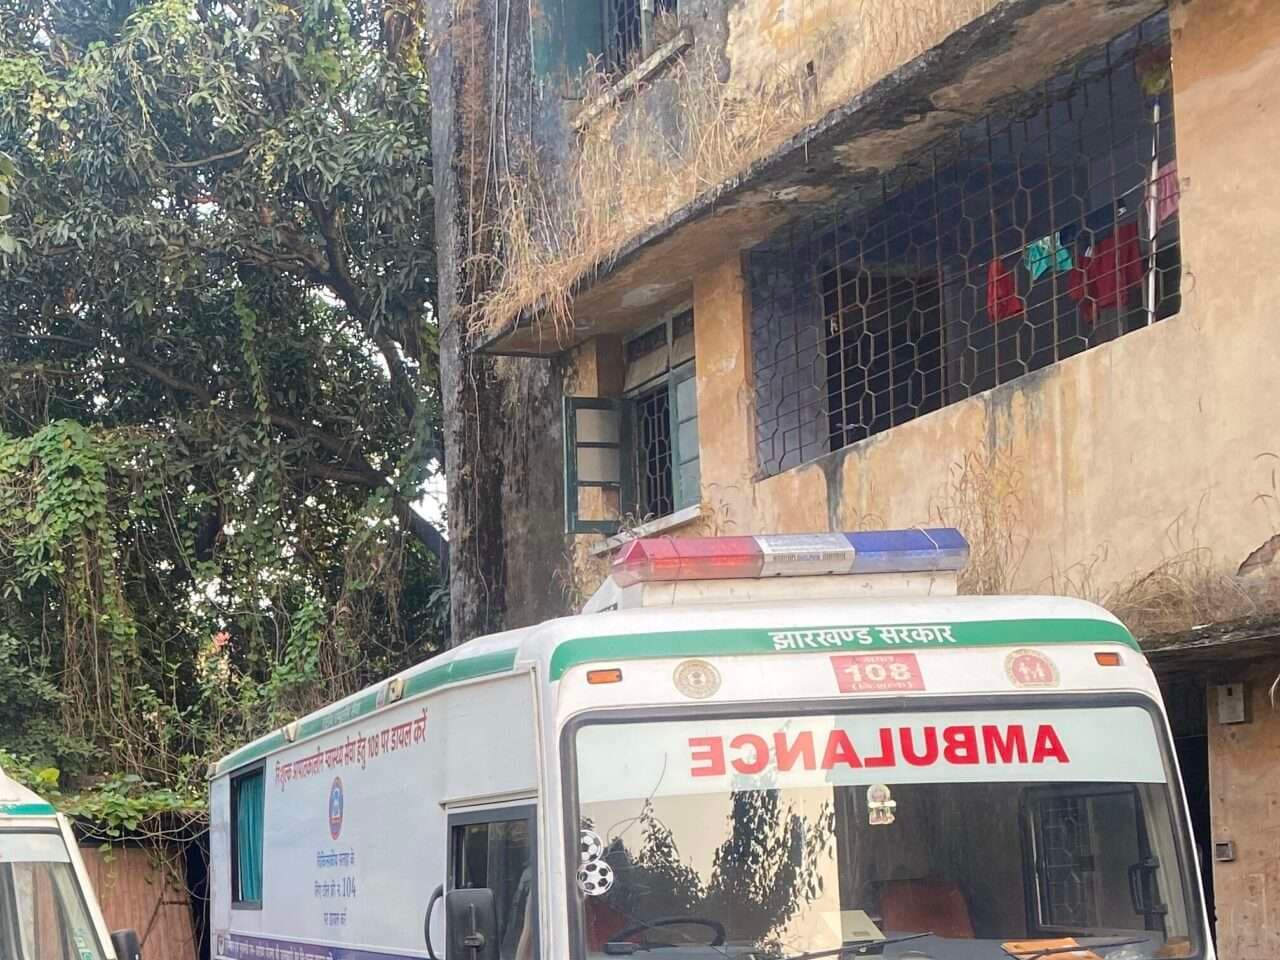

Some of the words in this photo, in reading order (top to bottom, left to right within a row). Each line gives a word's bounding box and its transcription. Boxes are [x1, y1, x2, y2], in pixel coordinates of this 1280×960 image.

[769, 626, 872, 650] झारखण्ड
[878, 624, 957, 645] सरकार
[844, 663, 912, 682] 108
[368, 735, 380, 758] 108
[381, 729, 391, 753] पर
[391, 722, 413, 751] डायल
[413, 707, 429, 745] करें
[342, 876, 357, 898] 104
